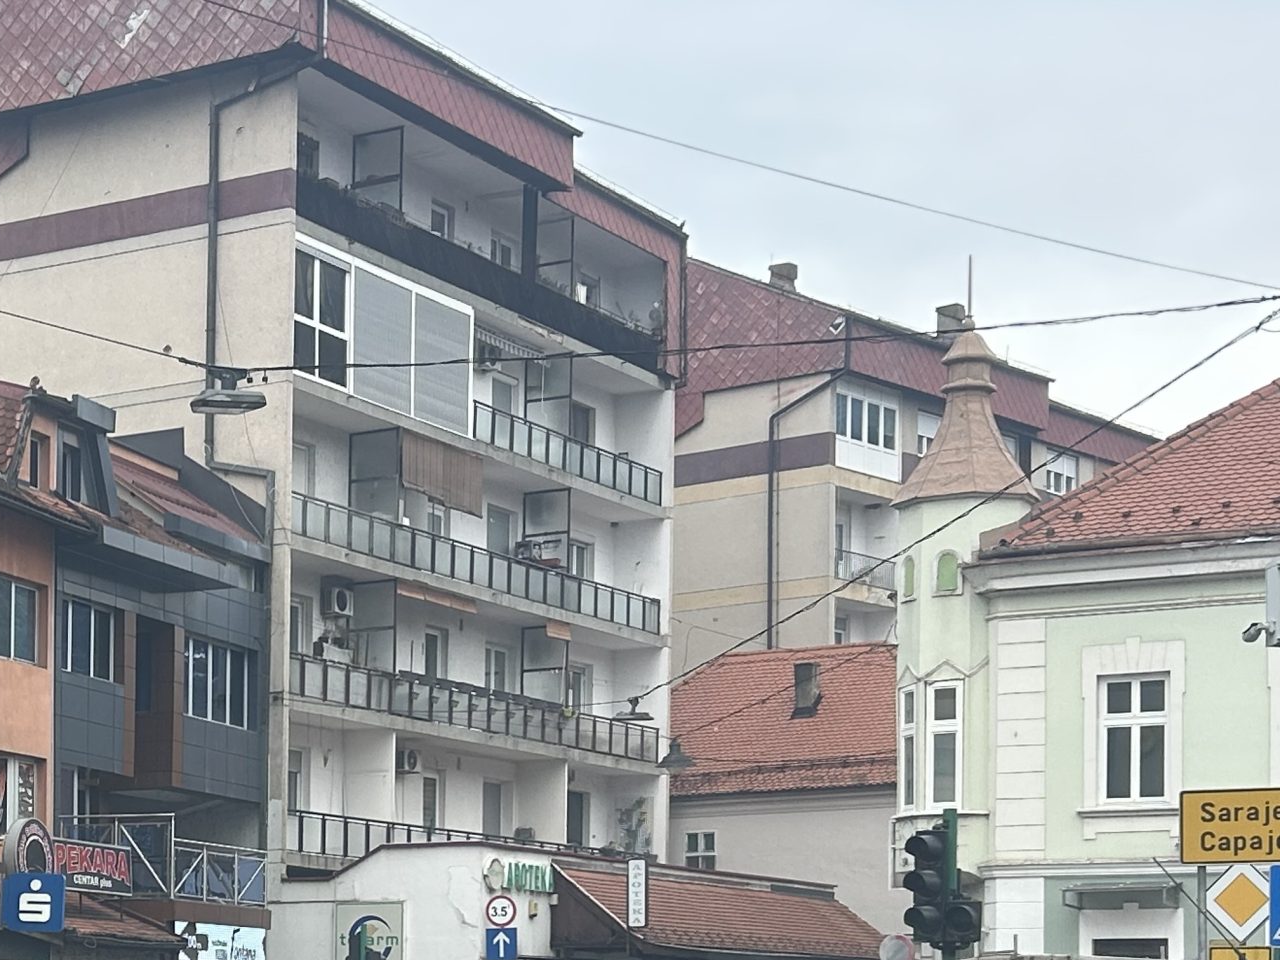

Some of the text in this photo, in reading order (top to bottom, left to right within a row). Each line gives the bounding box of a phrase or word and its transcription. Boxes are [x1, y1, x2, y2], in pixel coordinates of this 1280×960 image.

[53, 842, 132, 887] PEKARA
[507, 862, 554, 893] APOTEKA
[73, 874, 112, 888] CENTAR plus
[631, 863, 644, 924] APOTEKA
[339, 934, 399, 946] tarm
